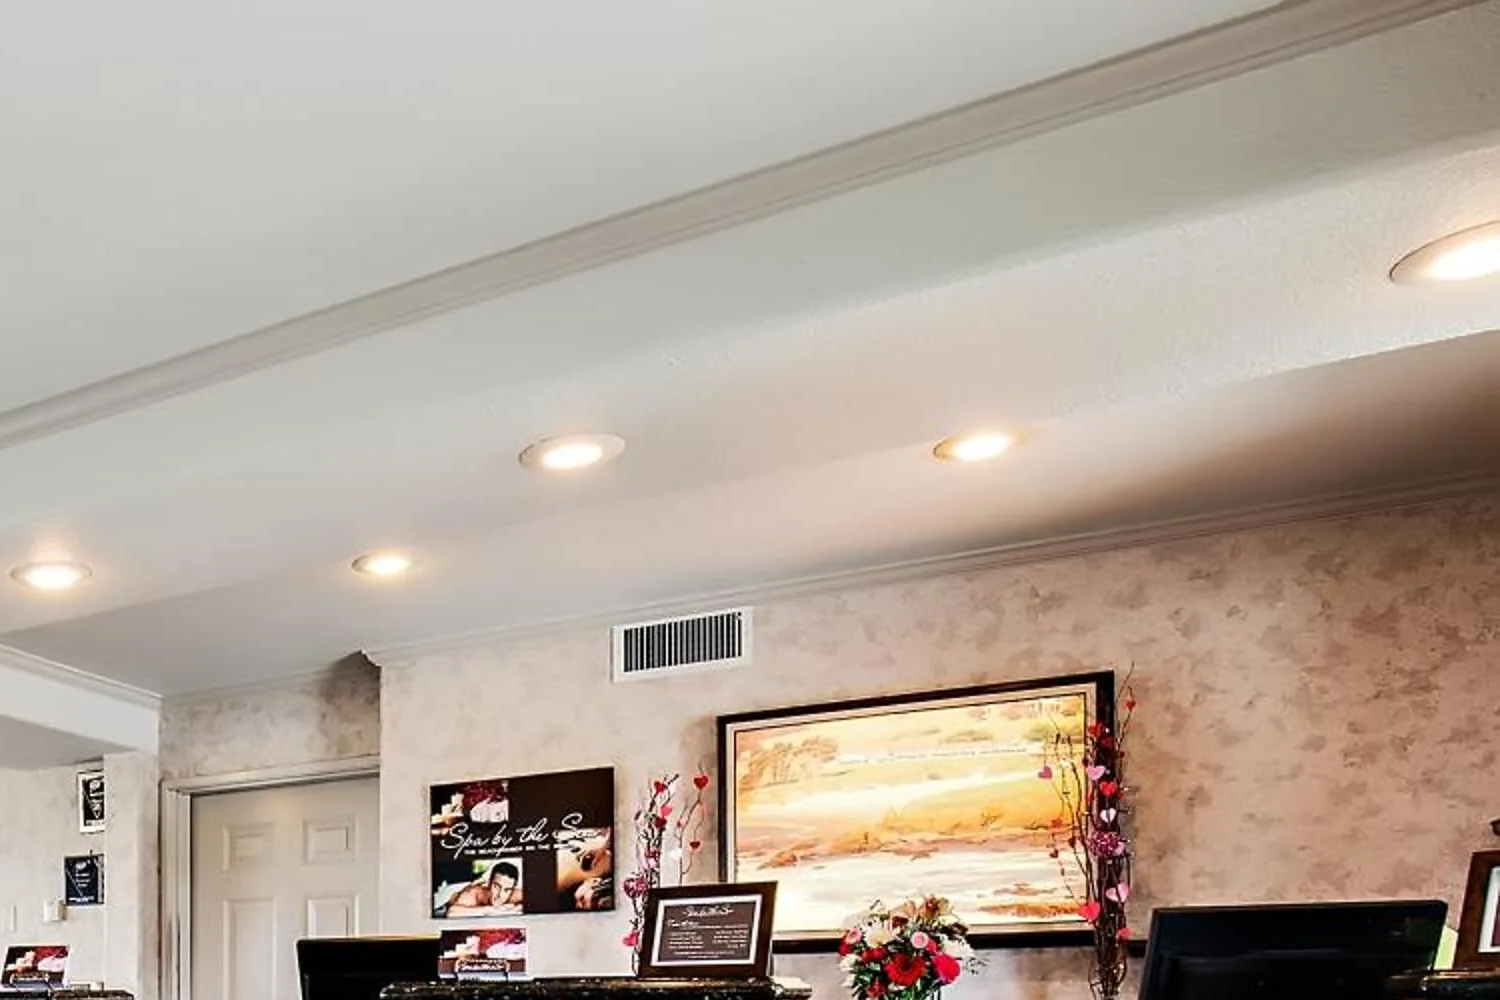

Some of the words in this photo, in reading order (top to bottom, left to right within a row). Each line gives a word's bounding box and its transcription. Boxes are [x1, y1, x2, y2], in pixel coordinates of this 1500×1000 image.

[441, 822, 489, 860] Spa
[491, 824, 513, 857] by
[515, 817, 549, 844] the
